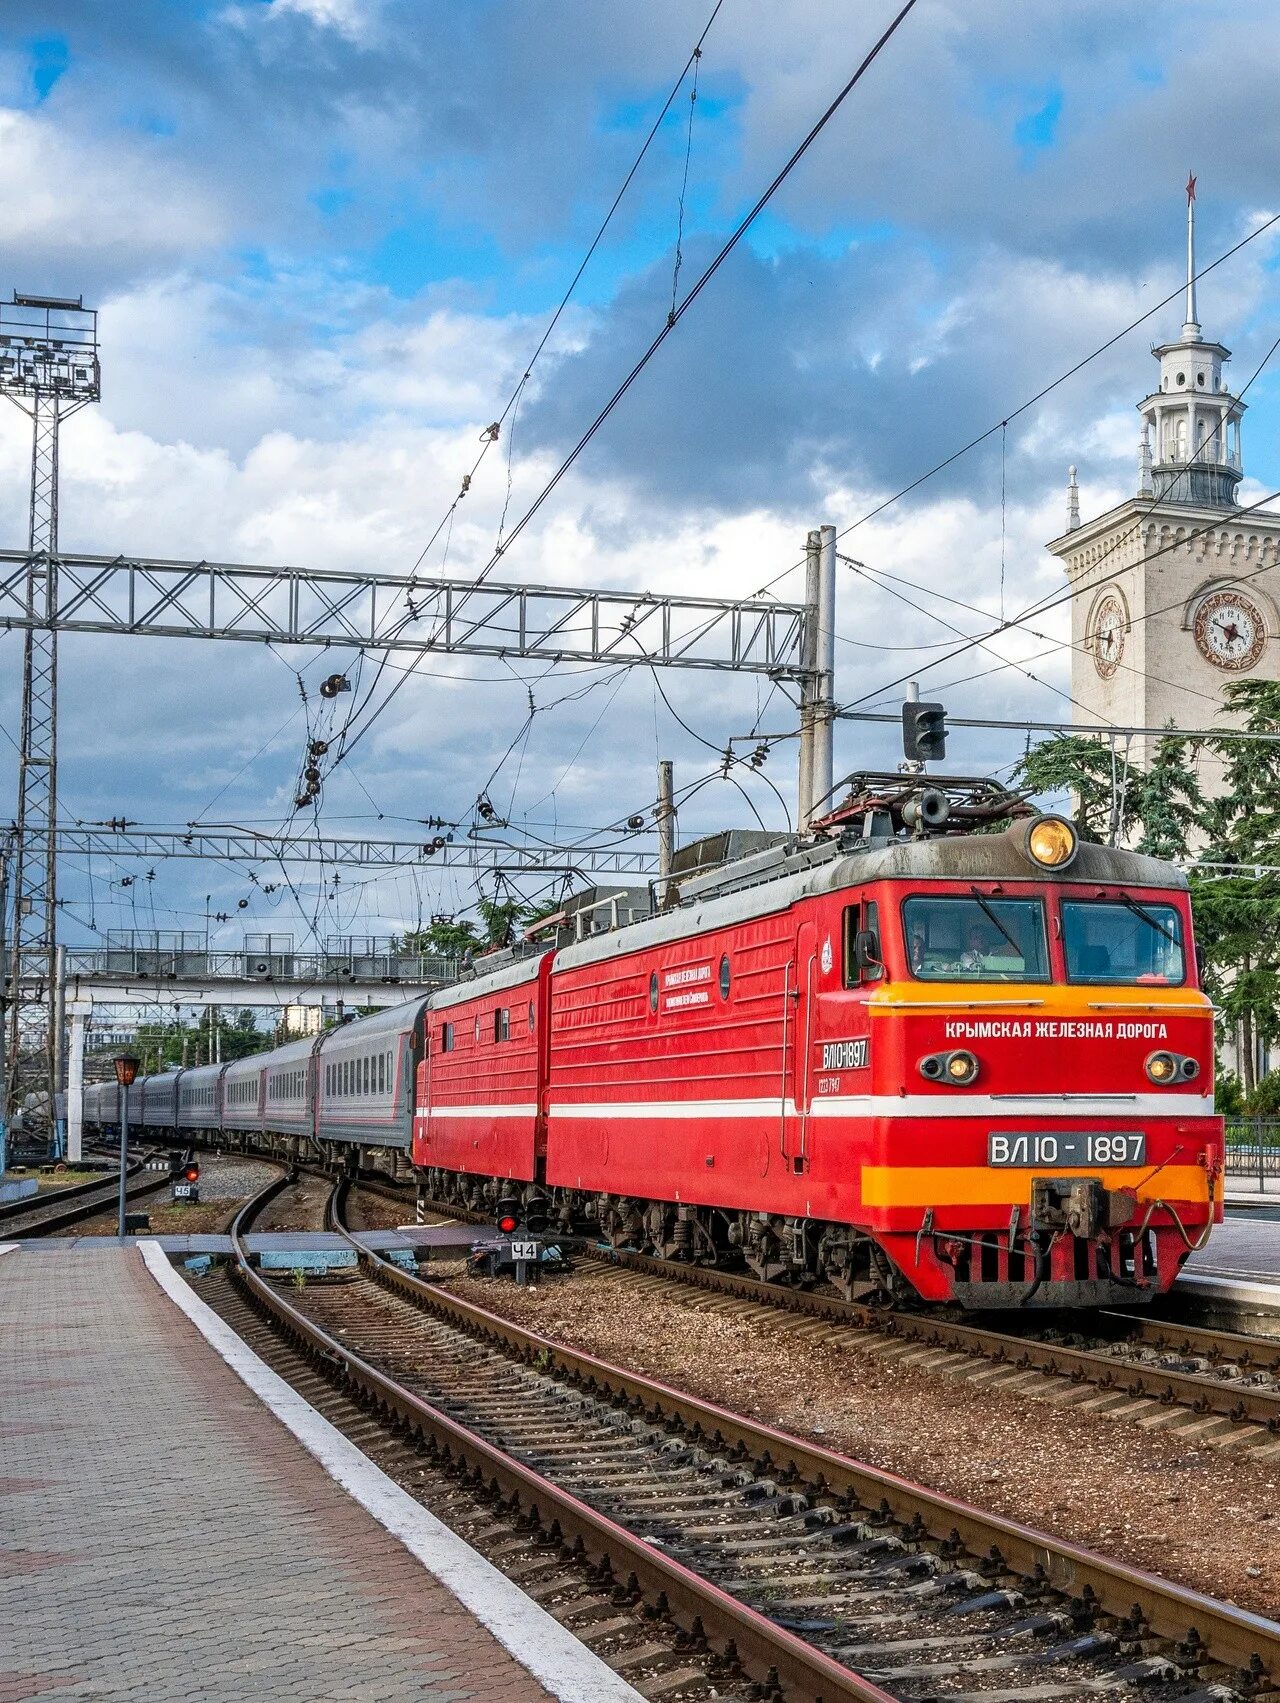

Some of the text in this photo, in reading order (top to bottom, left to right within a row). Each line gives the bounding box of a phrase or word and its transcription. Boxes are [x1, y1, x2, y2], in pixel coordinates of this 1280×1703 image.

[1227, 609, 1235, 618] 12
[946, 1021, 1168, 1039] КРЫМСКАЯ ЖЕЛЕЗНАЯ ДОРОГА
[991, 1136, 1058, 1163] ВЛ10
[1087, 1135, 1144, 1162] 1897
